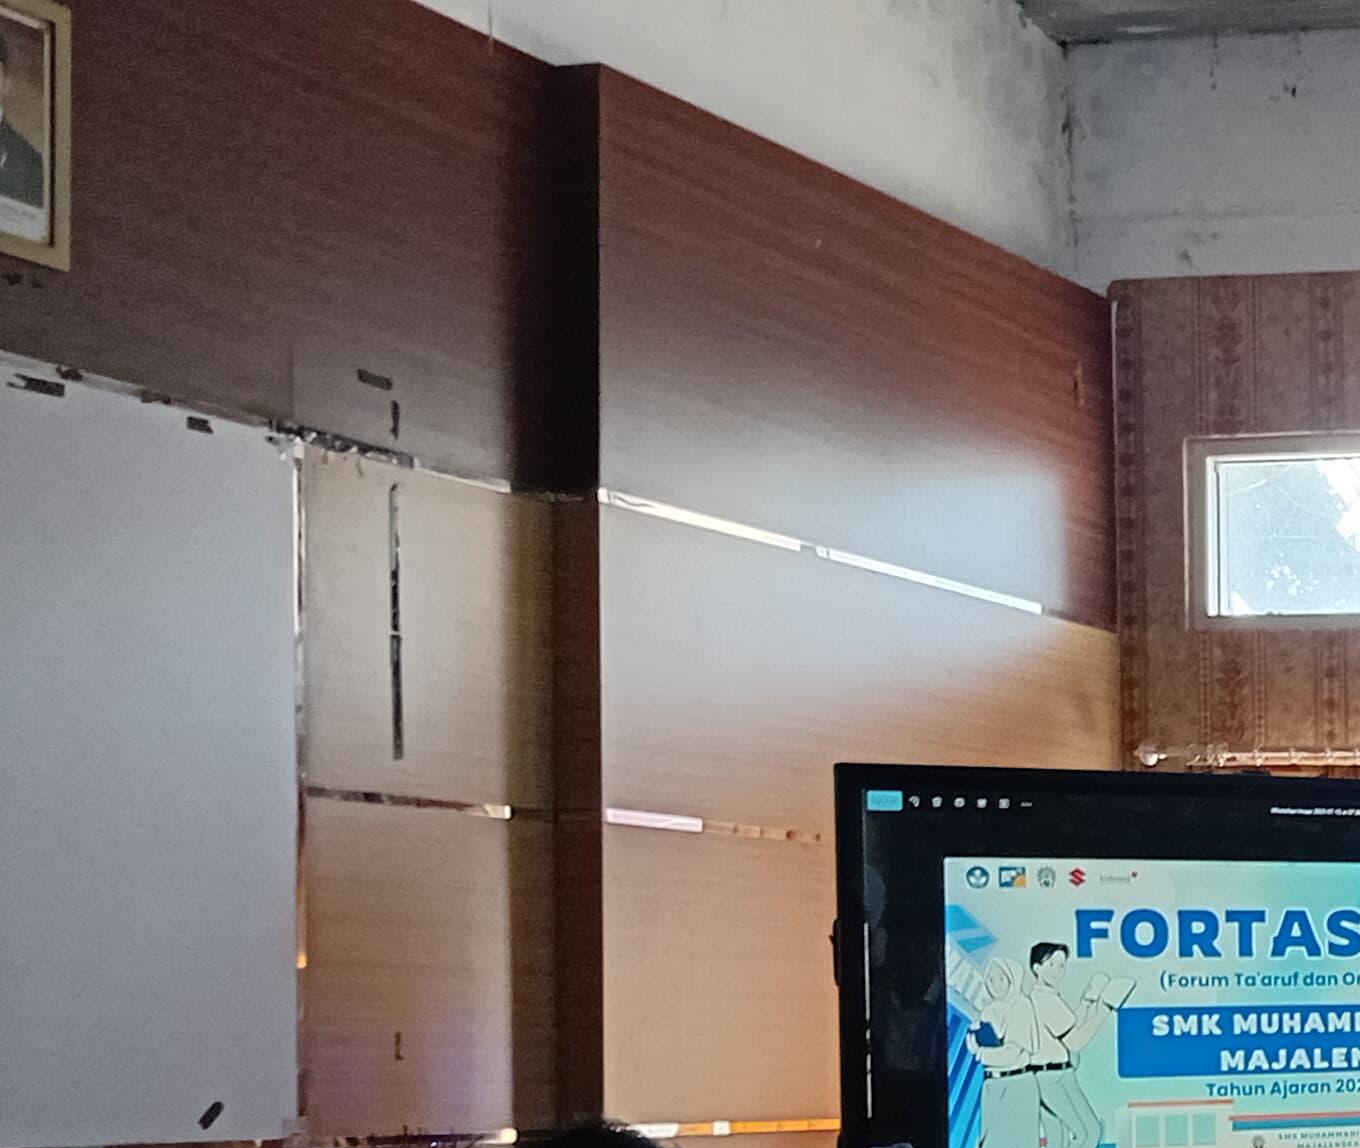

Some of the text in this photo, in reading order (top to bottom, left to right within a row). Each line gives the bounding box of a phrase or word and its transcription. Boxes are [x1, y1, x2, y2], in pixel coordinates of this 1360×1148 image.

[1160, 970, 1229, 991] (Forum
[1234, 971, 1300, 988] Ta'aruf
[1302, 970, 1338, 987] dan
[1152, 1013, 1223, 1036] SMK
[1206, 1082, 1265, 1097] Tahun
[1270, 1080, 1331, 1099] Ajaran
